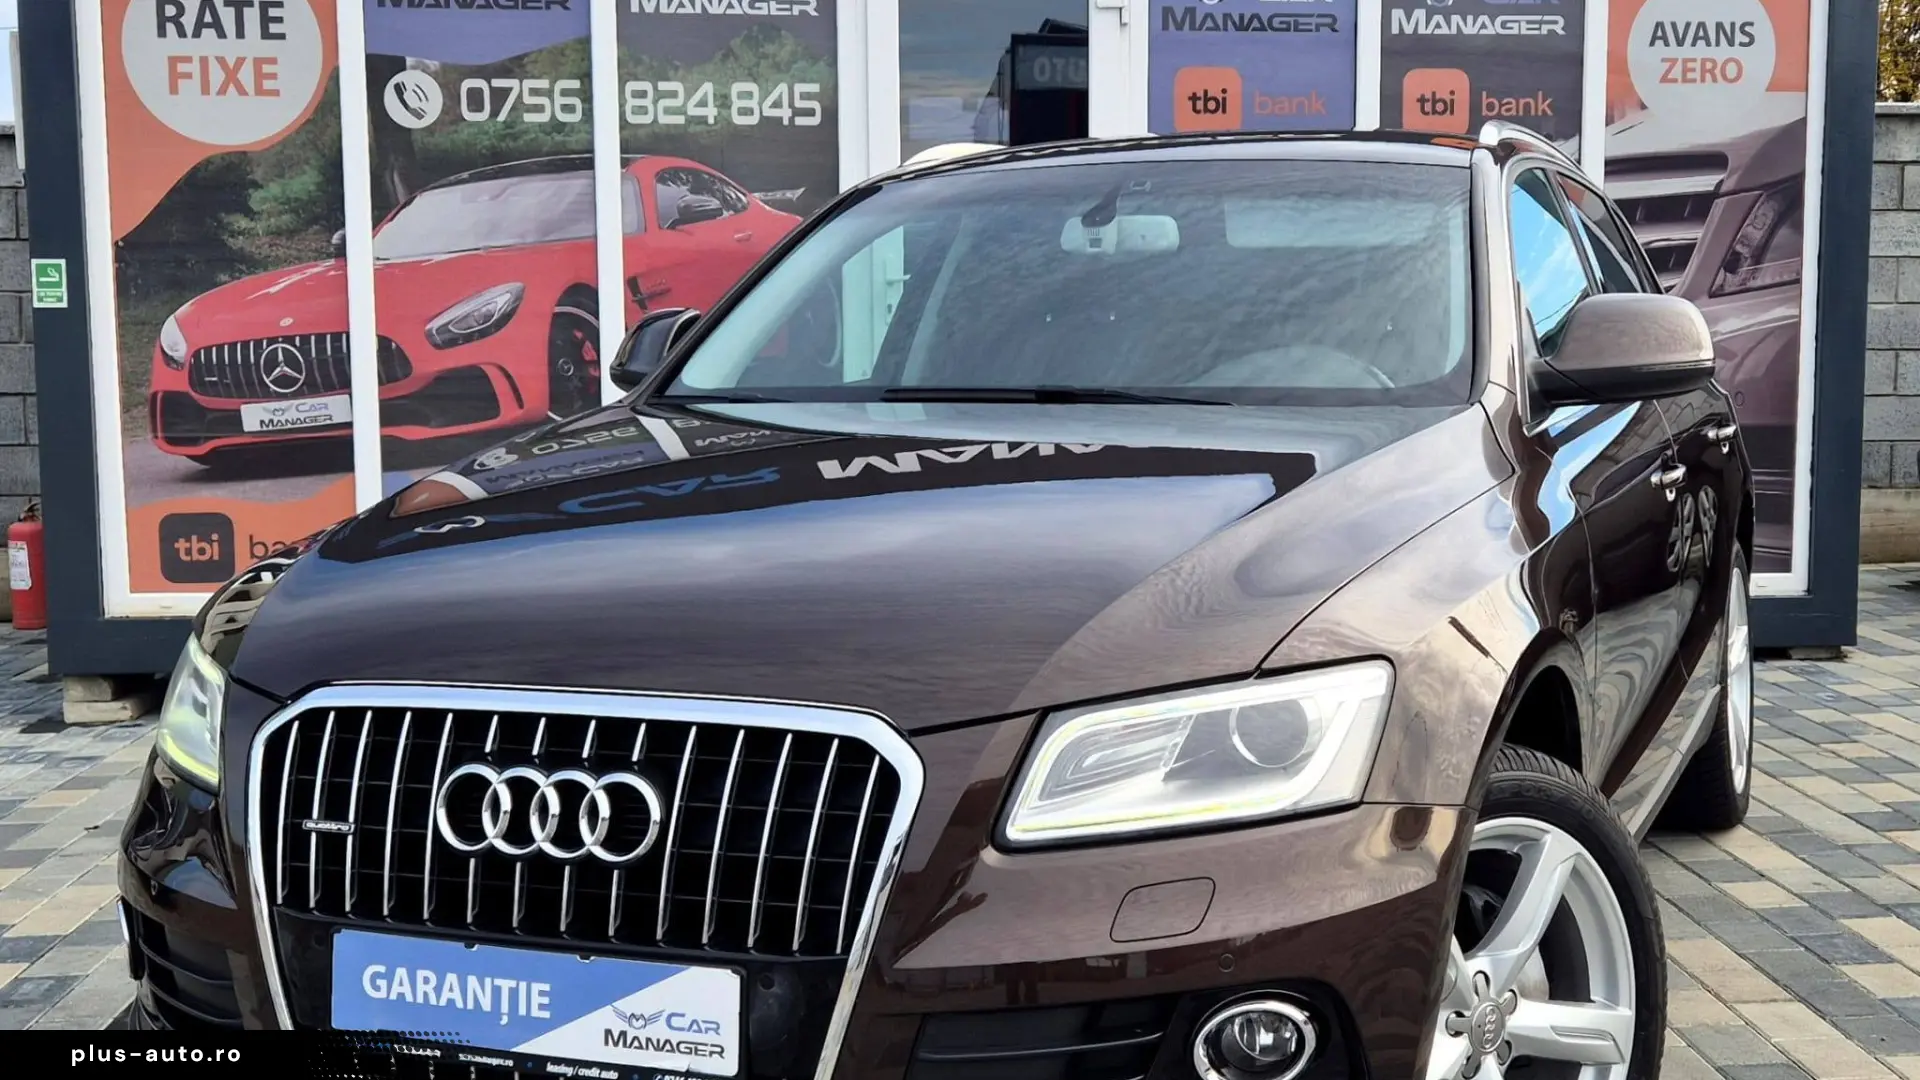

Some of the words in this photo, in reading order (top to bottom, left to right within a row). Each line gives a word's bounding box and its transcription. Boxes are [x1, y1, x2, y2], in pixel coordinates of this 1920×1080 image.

[156, 0, 286, 40] RATE
[1161, 6, 1339, 33] MANAGER
[1391, 8, 1566, 36] MANAGER
[1649, 21, 1756, 48] AVANS
[167, 56, 280, 97] FIXE
[1659, 57, 1744, 84] ZERO
[460, 78, 583, 123] 0756
[624, 80, 718, 125] 824
[730, 81, 822, 126] 845
[1187, 88, 1228, 115] tbi
[1253, 90, 1327, 116] bank
[1416, 90, 1456, 116] tbi
[1481, 91, 1553, 117] bank
[259, 414, 333, 429] MANAGER
[295, 402, 329, 413] CAR
[174, 533, 219, 562] tbi
[362, 964, 550, 1025] GARANȚIE
[666, 1012, 721, 1036] CAR
[603, 1028, 725, 1059] MANAGER
